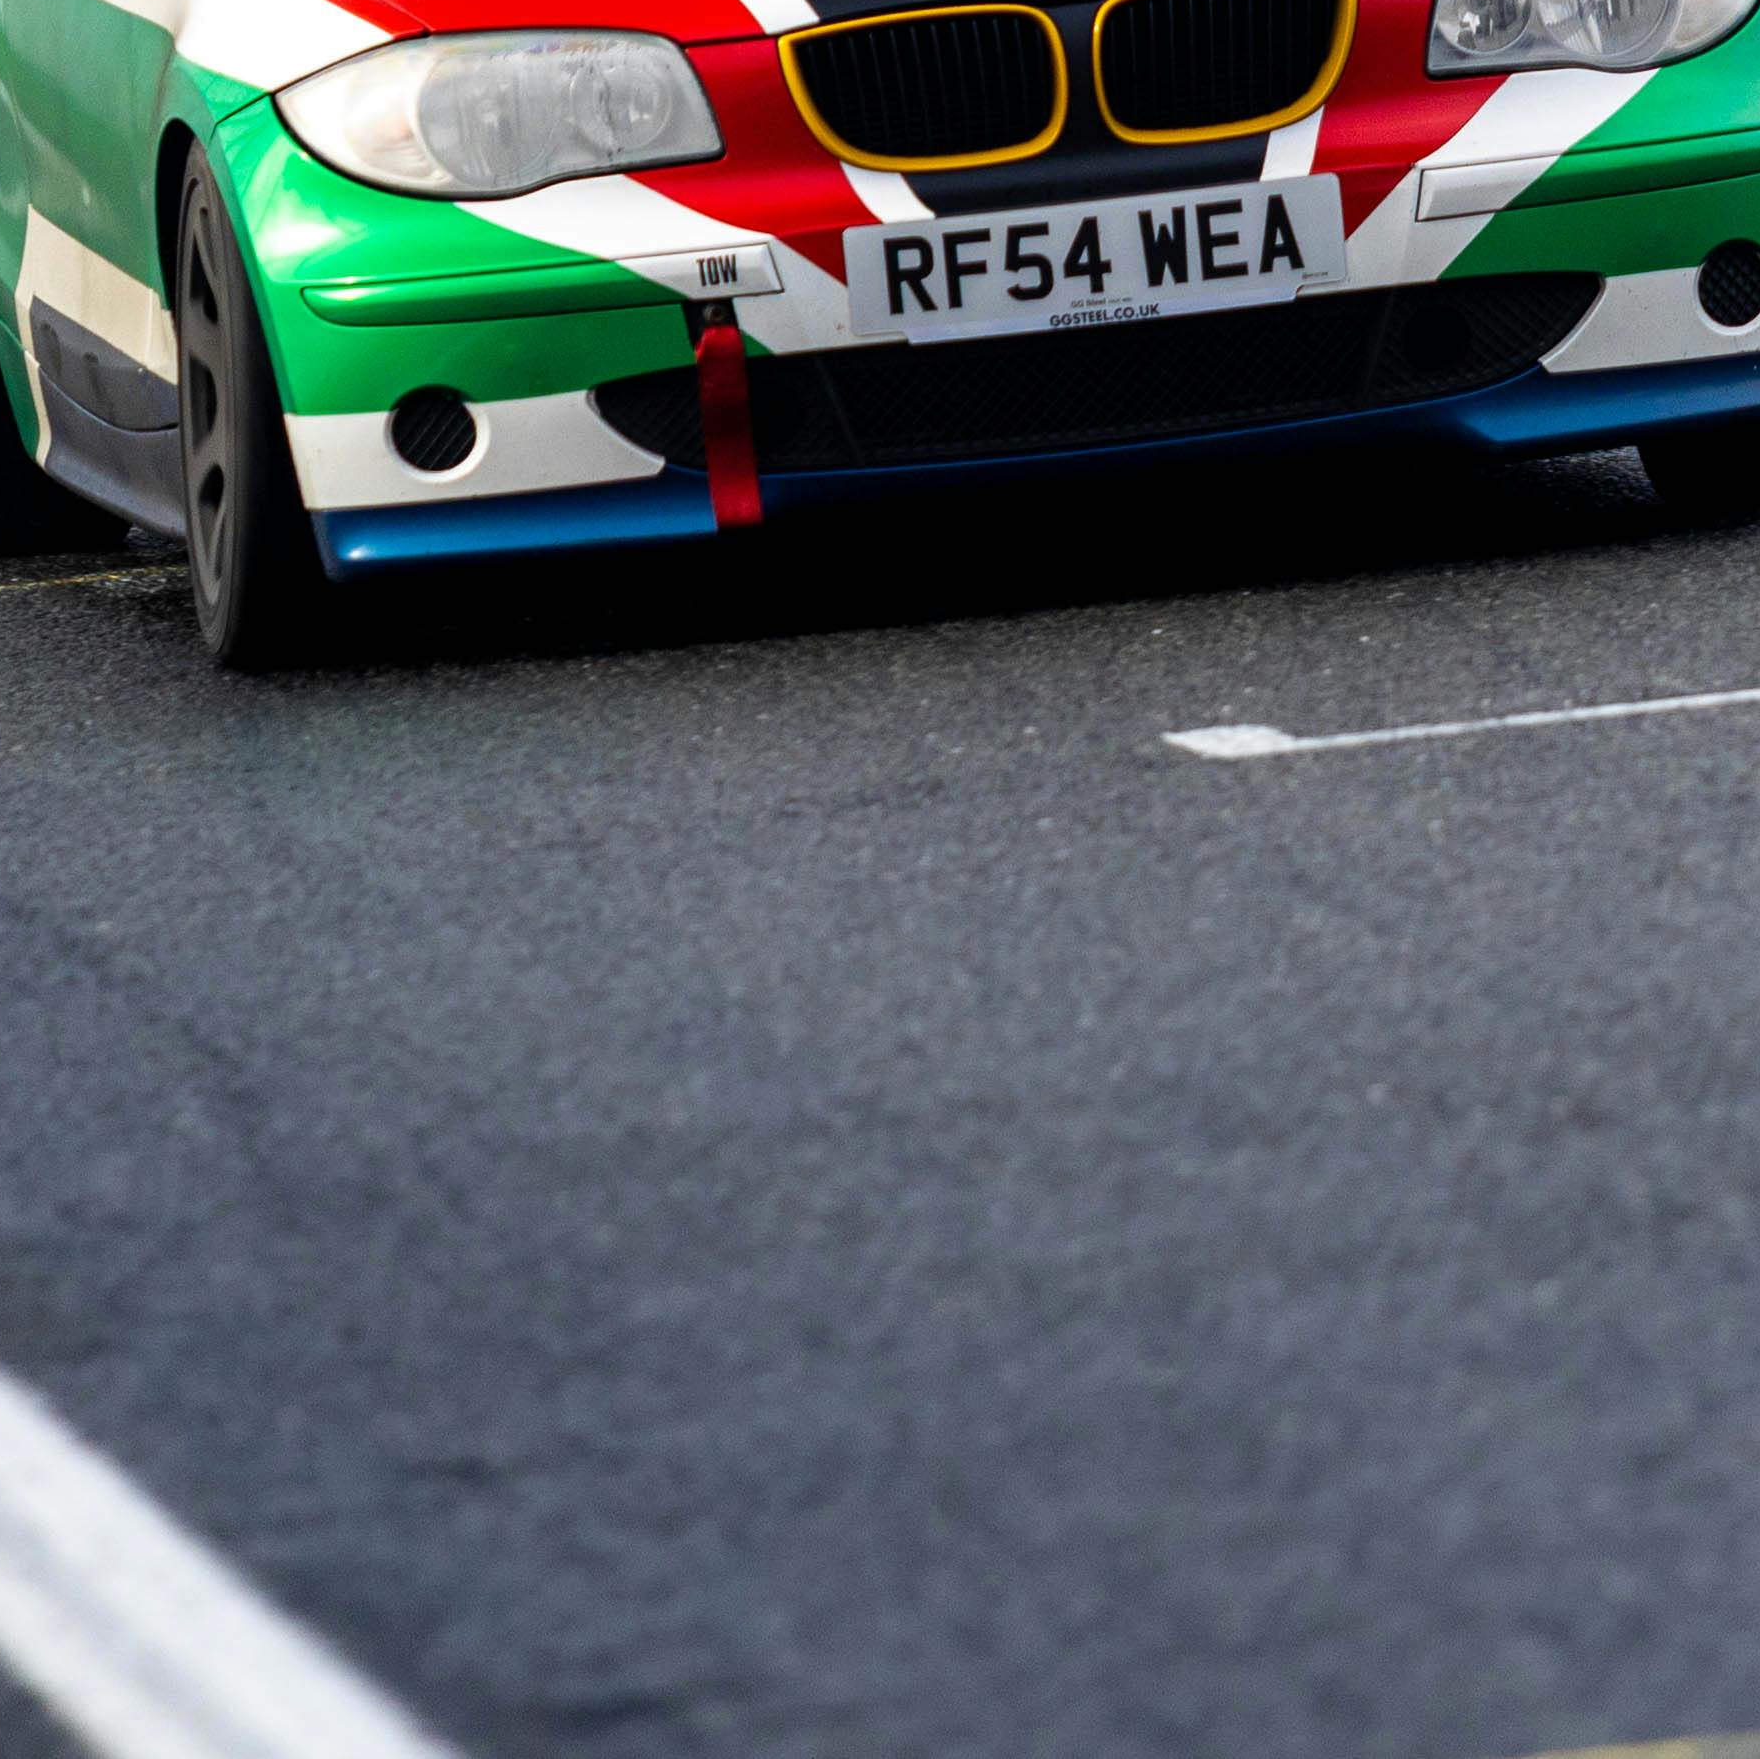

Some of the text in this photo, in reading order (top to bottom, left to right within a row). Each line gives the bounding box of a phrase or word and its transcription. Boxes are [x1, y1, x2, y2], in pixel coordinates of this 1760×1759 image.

[695, 253, 738, 287] TOW
[882, 193, 1306, 316] RF54 WEA
[1049, 303, 1160, 327] GGSTEEL.CO.UK
